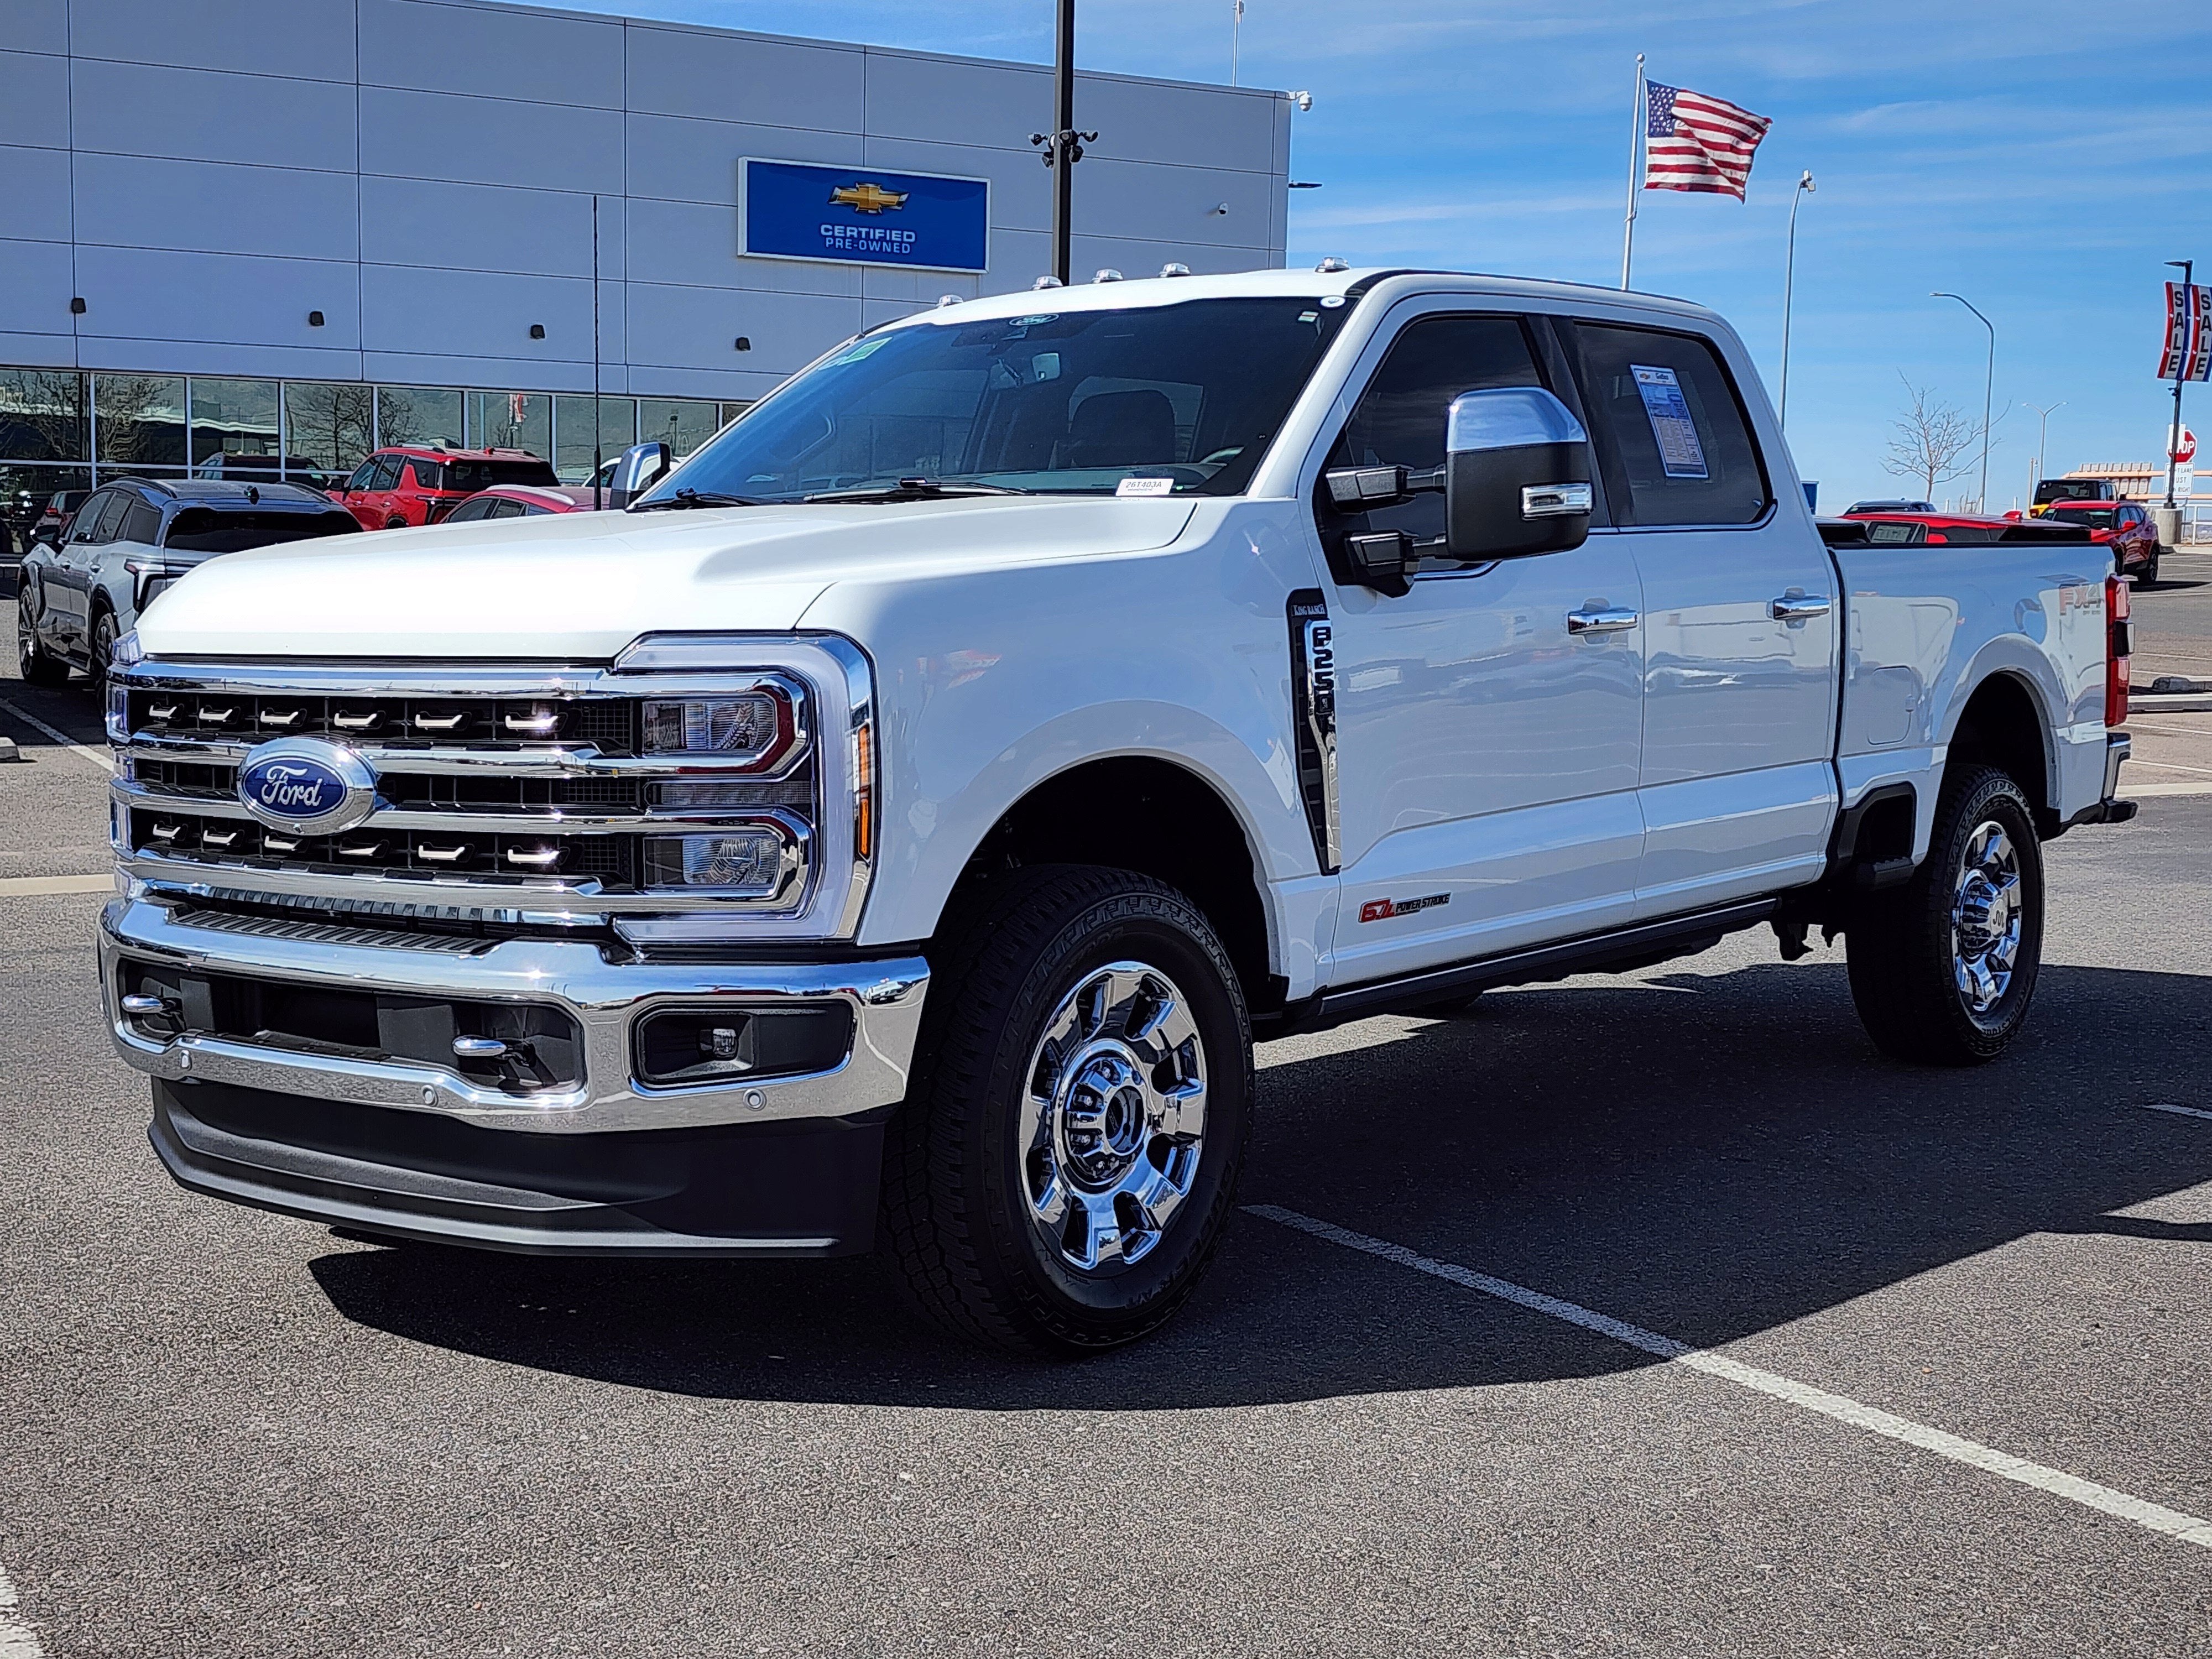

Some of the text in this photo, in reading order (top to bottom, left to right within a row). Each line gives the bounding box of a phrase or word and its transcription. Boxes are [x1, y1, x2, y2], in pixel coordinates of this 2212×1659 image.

[820, 224, 916, 242] CERTIFIED
[826, 237, 911, 254] PRE-OWNED
[2168, 290, 2184, 372] SALE
[2195, 294, 2212, 374] SALE
[2059, 585, 2101, 615] FX4
[261, 765, 324, 807] Ford
[1396, 899, 1421, 912] POWER
[1421, 894, 1450, 909] STROKE
